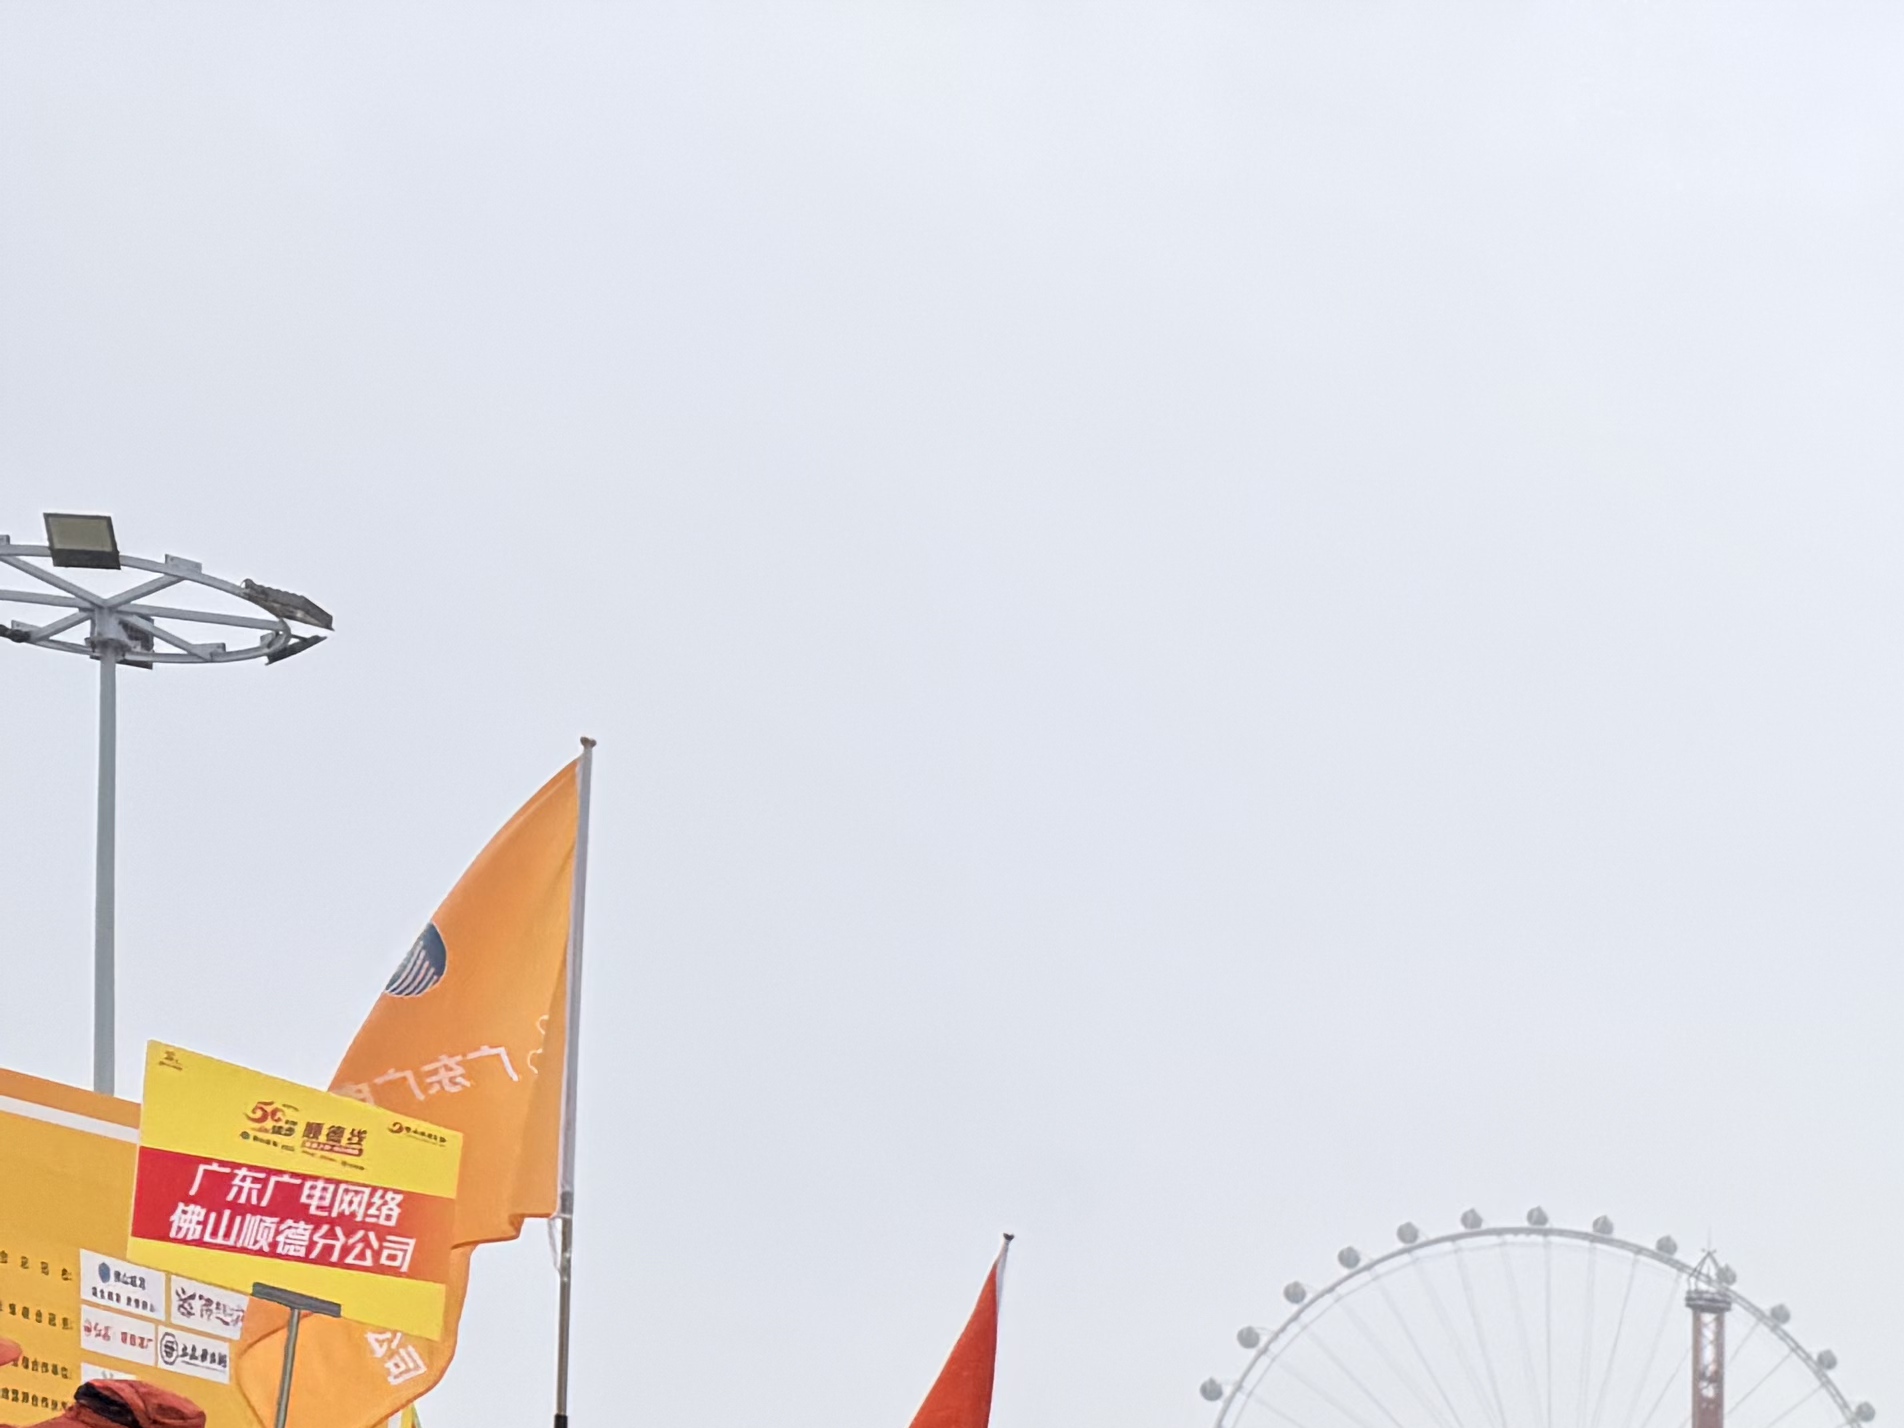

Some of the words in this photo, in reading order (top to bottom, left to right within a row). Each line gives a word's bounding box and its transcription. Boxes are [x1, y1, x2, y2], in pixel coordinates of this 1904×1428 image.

[189, 1162, 404, 1227] 广东广电网络
[169, 1202, 416, 1273] 佛山顺德分公司
